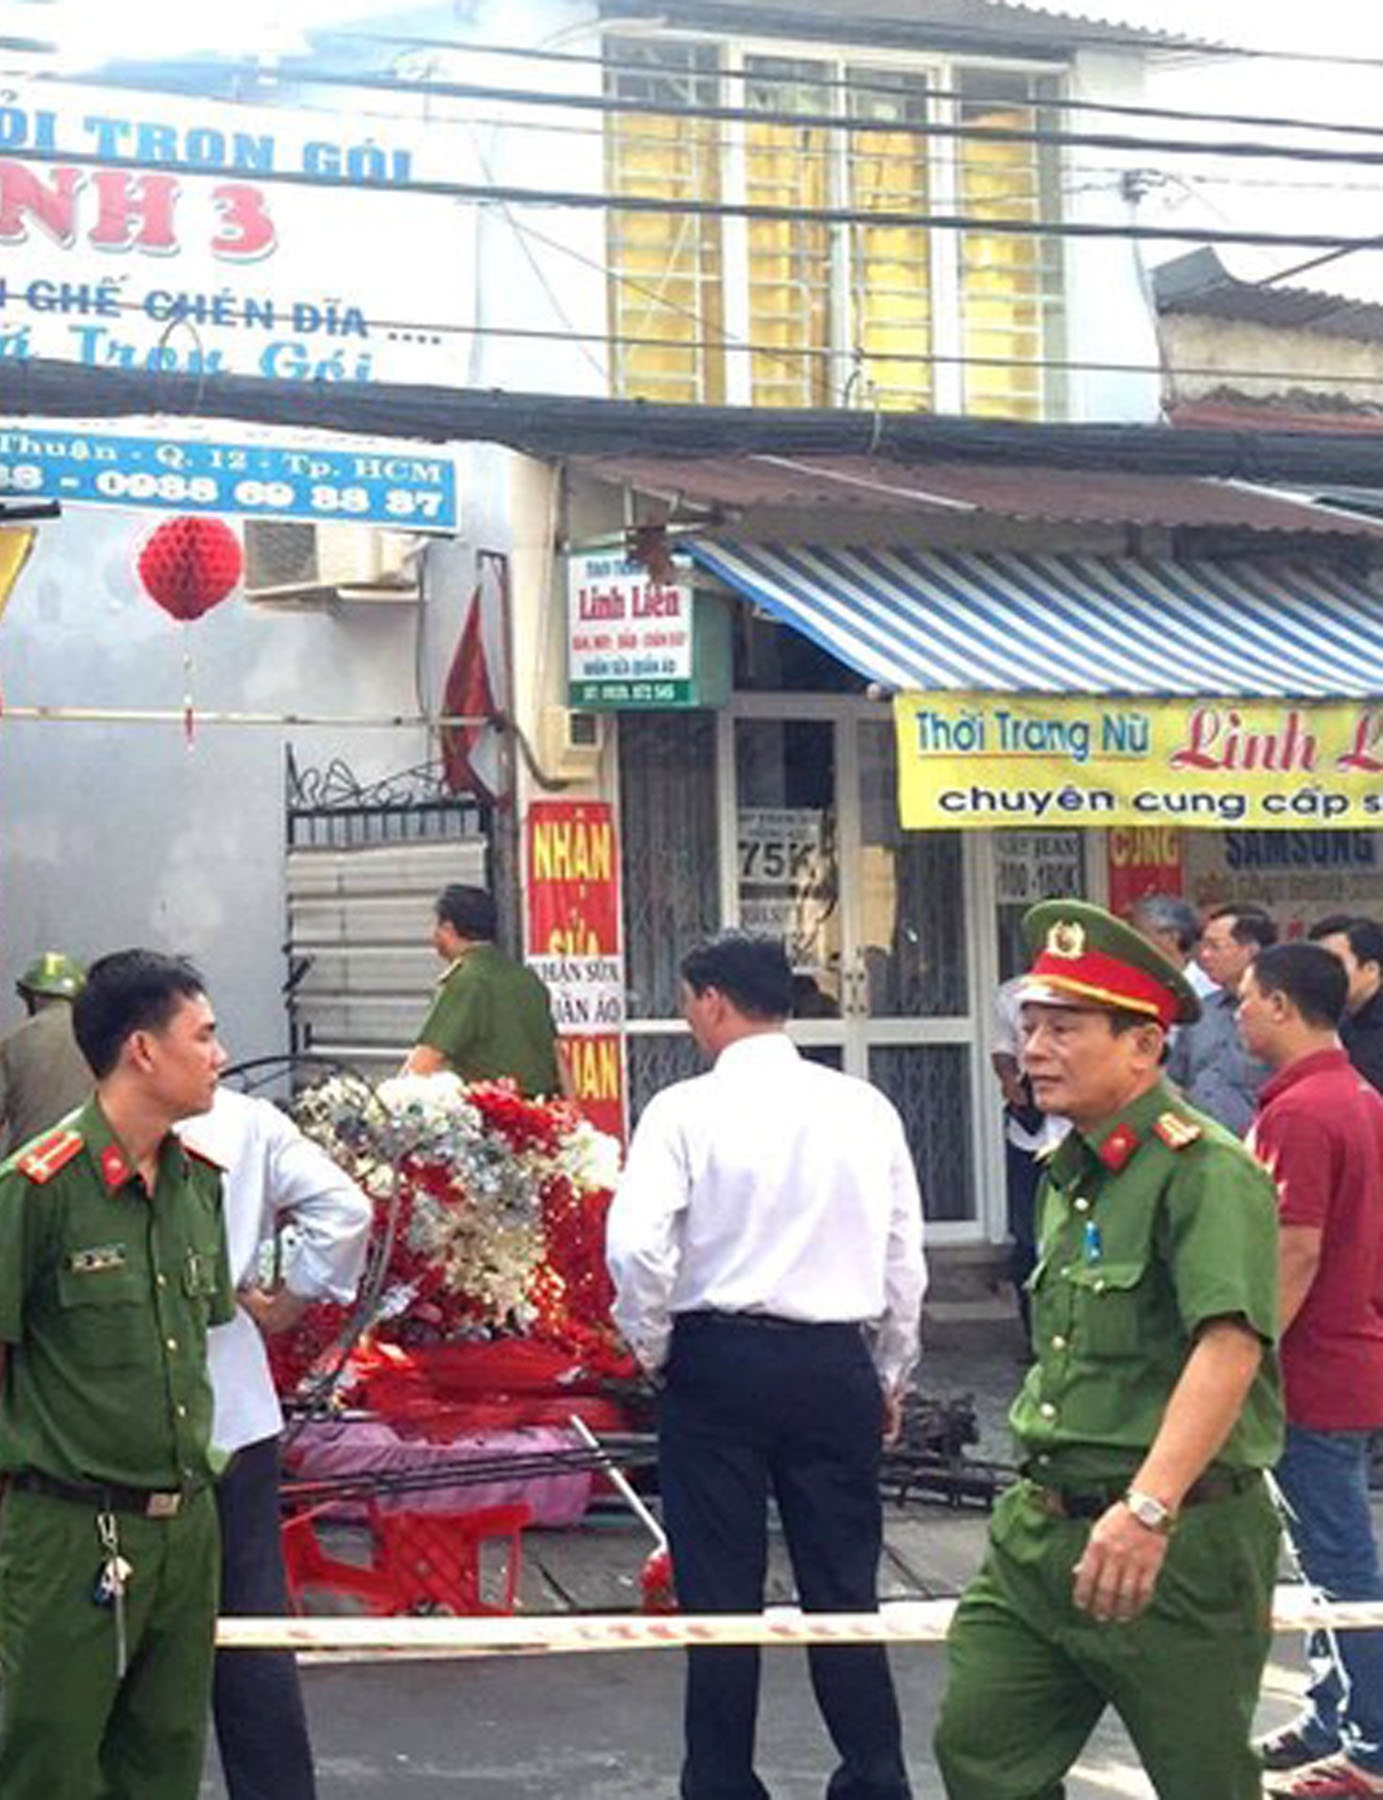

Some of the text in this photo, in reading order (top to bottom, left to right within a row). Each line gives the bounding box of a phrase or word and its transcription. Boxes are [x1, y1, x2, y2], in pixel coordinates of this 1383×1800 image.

[211, 184, 279, 265] 3
[27, 274, 129, 317] GHẾ
[144, 286, 276, 330] CHÉN
[154, 444, 193, 469] Q.
[281, 453, 341, 477] Tp.
[352, 456, 443, 483] HCM
[579, 586, 625, 621] Linh
[916, 708, 985, 751] Thời
[994, 711, 1090, 762] Trang
[1170, 706, 1316, 771] Linh
[938, 784, 1116, 817] chuyên
[1132, 791, 1246, 818] cung
[1262, 784, 1349, 817] cấp
